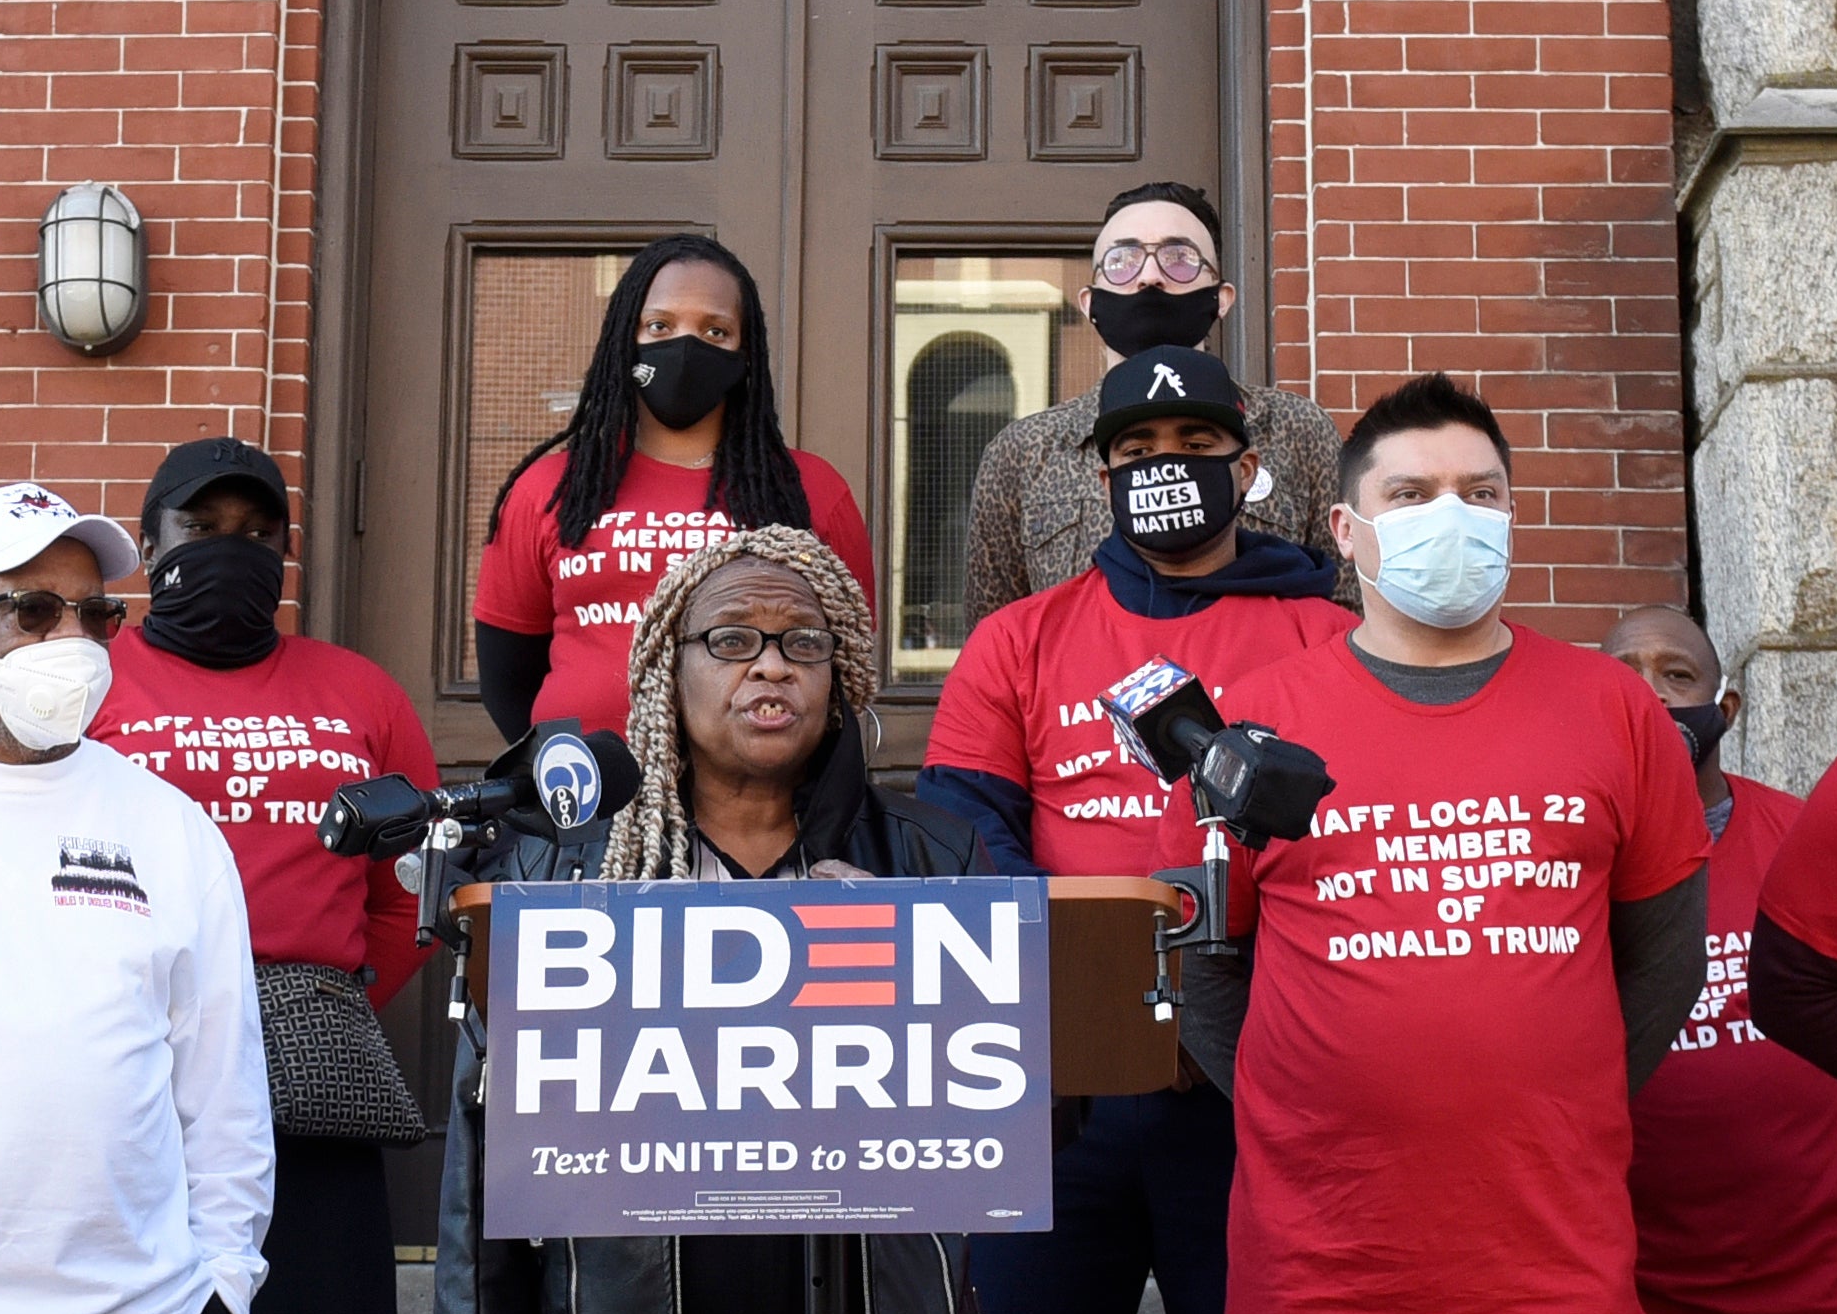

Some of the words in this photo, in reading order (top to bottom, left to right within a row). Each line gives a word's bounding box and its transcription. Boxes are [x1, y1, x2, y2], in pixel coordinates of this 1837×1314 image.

[1132, 464, 1189, 487] BLACK
[1136, 487, 1191, 509] LIVES
[1132, 508, 1205, 534] MATTER
[559, 552, 606, 580] NOT
[619, 551, 652, 572] IN
[1108, 660, 1161, 696] FOX
[1120, 667, 1174, 710] 29
[120, 716, 193, 735] IAFF
[203, 715, 306, 731] LOCAL
[312, 716, 351, 734] 22
[174, 730, 311, 748] MEMBER
[127, 751, 171, 771] OT
[185, 750, 220, 771] IN
[232, 749, 370, 779] SUPPORT
[225, 776, 269, 798] OF
[264, 801, 329, 824] TRU
[557, 788, 571, 826] abc
[1310, 805, 1395, 838] IAFF
[1408, 795, 1531, 829] LOCAL
[1543, 794, 1586, 824] 22
[1376, 828, 1532, 862] MEMBER
[1315, 869, 1377, 901] NOT
[1390, 867, 1429, 892] IN
[1441, 861, 1581, 891] SUPPORT
[1437, 895, 1484, 923] OF
[516, 901, 1020, 1011] BIDEN
[1328, 929, 1471, 961] DONALD
[1482, 926, 1580, 954] TRUMP
[515, 1022, 1027, 1114] HARRIS
[531, 1146, 609, 1176] Text
[620, 1140, 799, 1173] UNITED
[810, 1145, 847, 1172] to
[859, 1138, 1004, 1171] 30330
